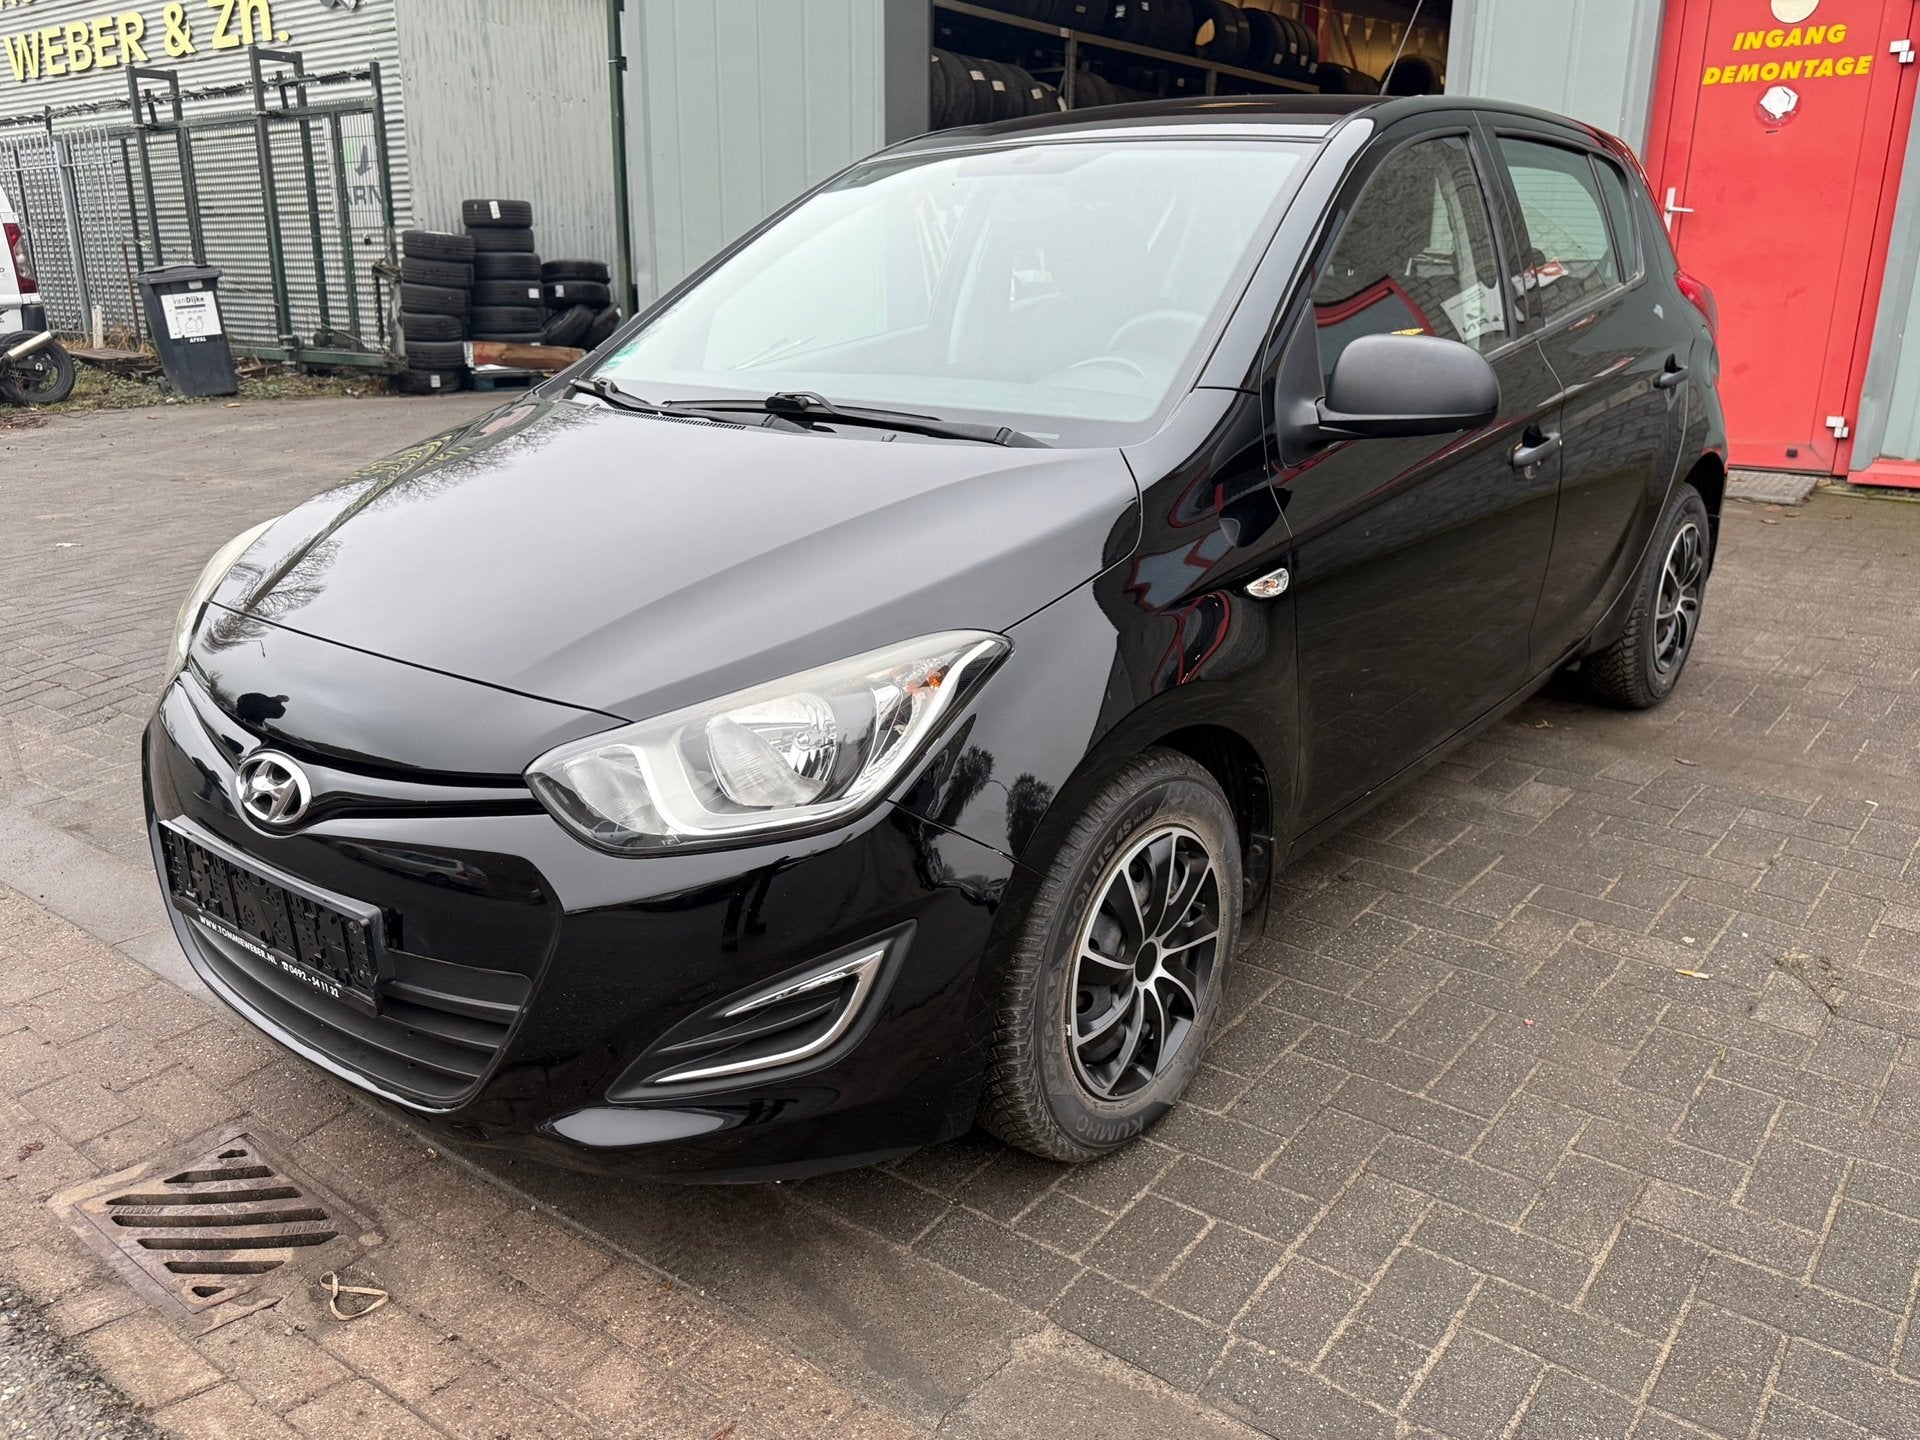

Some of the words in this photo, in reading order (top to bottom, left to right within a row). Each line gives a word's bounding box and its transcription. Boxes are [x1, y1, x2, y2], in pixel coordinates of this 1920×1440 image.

[3, 12, 148, 81] WEBER
[163, 2, 197, 57] &
[207, 0, 290, 49] Zn.
[1732, 23, 1848, 51] INGANG
[1701, 55, 1873, 86] DEMONTAGE
[1076, 1115, 1144, 1141] KUMHO
